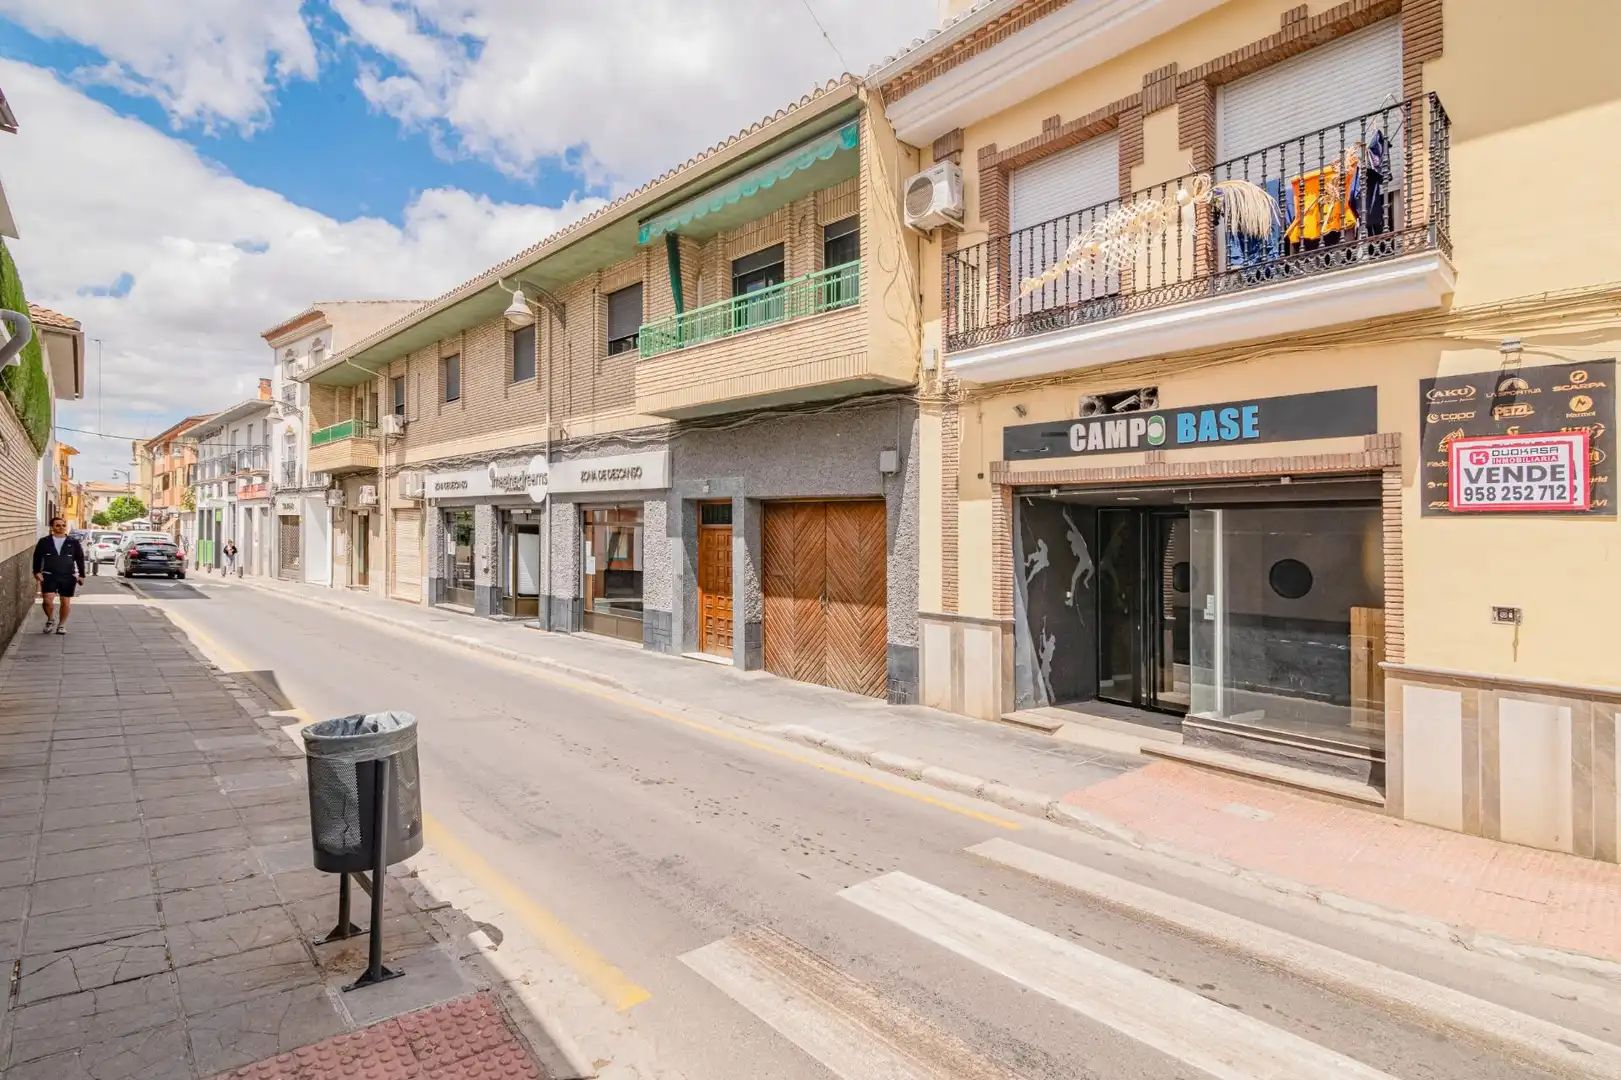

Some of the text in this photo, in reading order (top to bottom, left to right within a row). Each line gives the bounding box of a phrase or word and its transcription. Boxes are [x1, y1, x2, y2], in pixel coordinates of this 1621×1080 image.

[1433, 387, 1469, 398] AKU
[1552, 382, 1607, 392] SCARPA
[1494, 404, 1536, 421] PETZL
[1070, 405, 1260, 452] CAMPO BASE
[1491, 446, 1559, 457] DUOKASA
[1492, 455, 1559, 464] INMOBILIARIA
[1463, 464, 1566, 484] VENDE
[1464, 486, 1496, 502] 958
[1501, 485, 1534, 501] 252
[1538, 484, 1567, 501] 712
